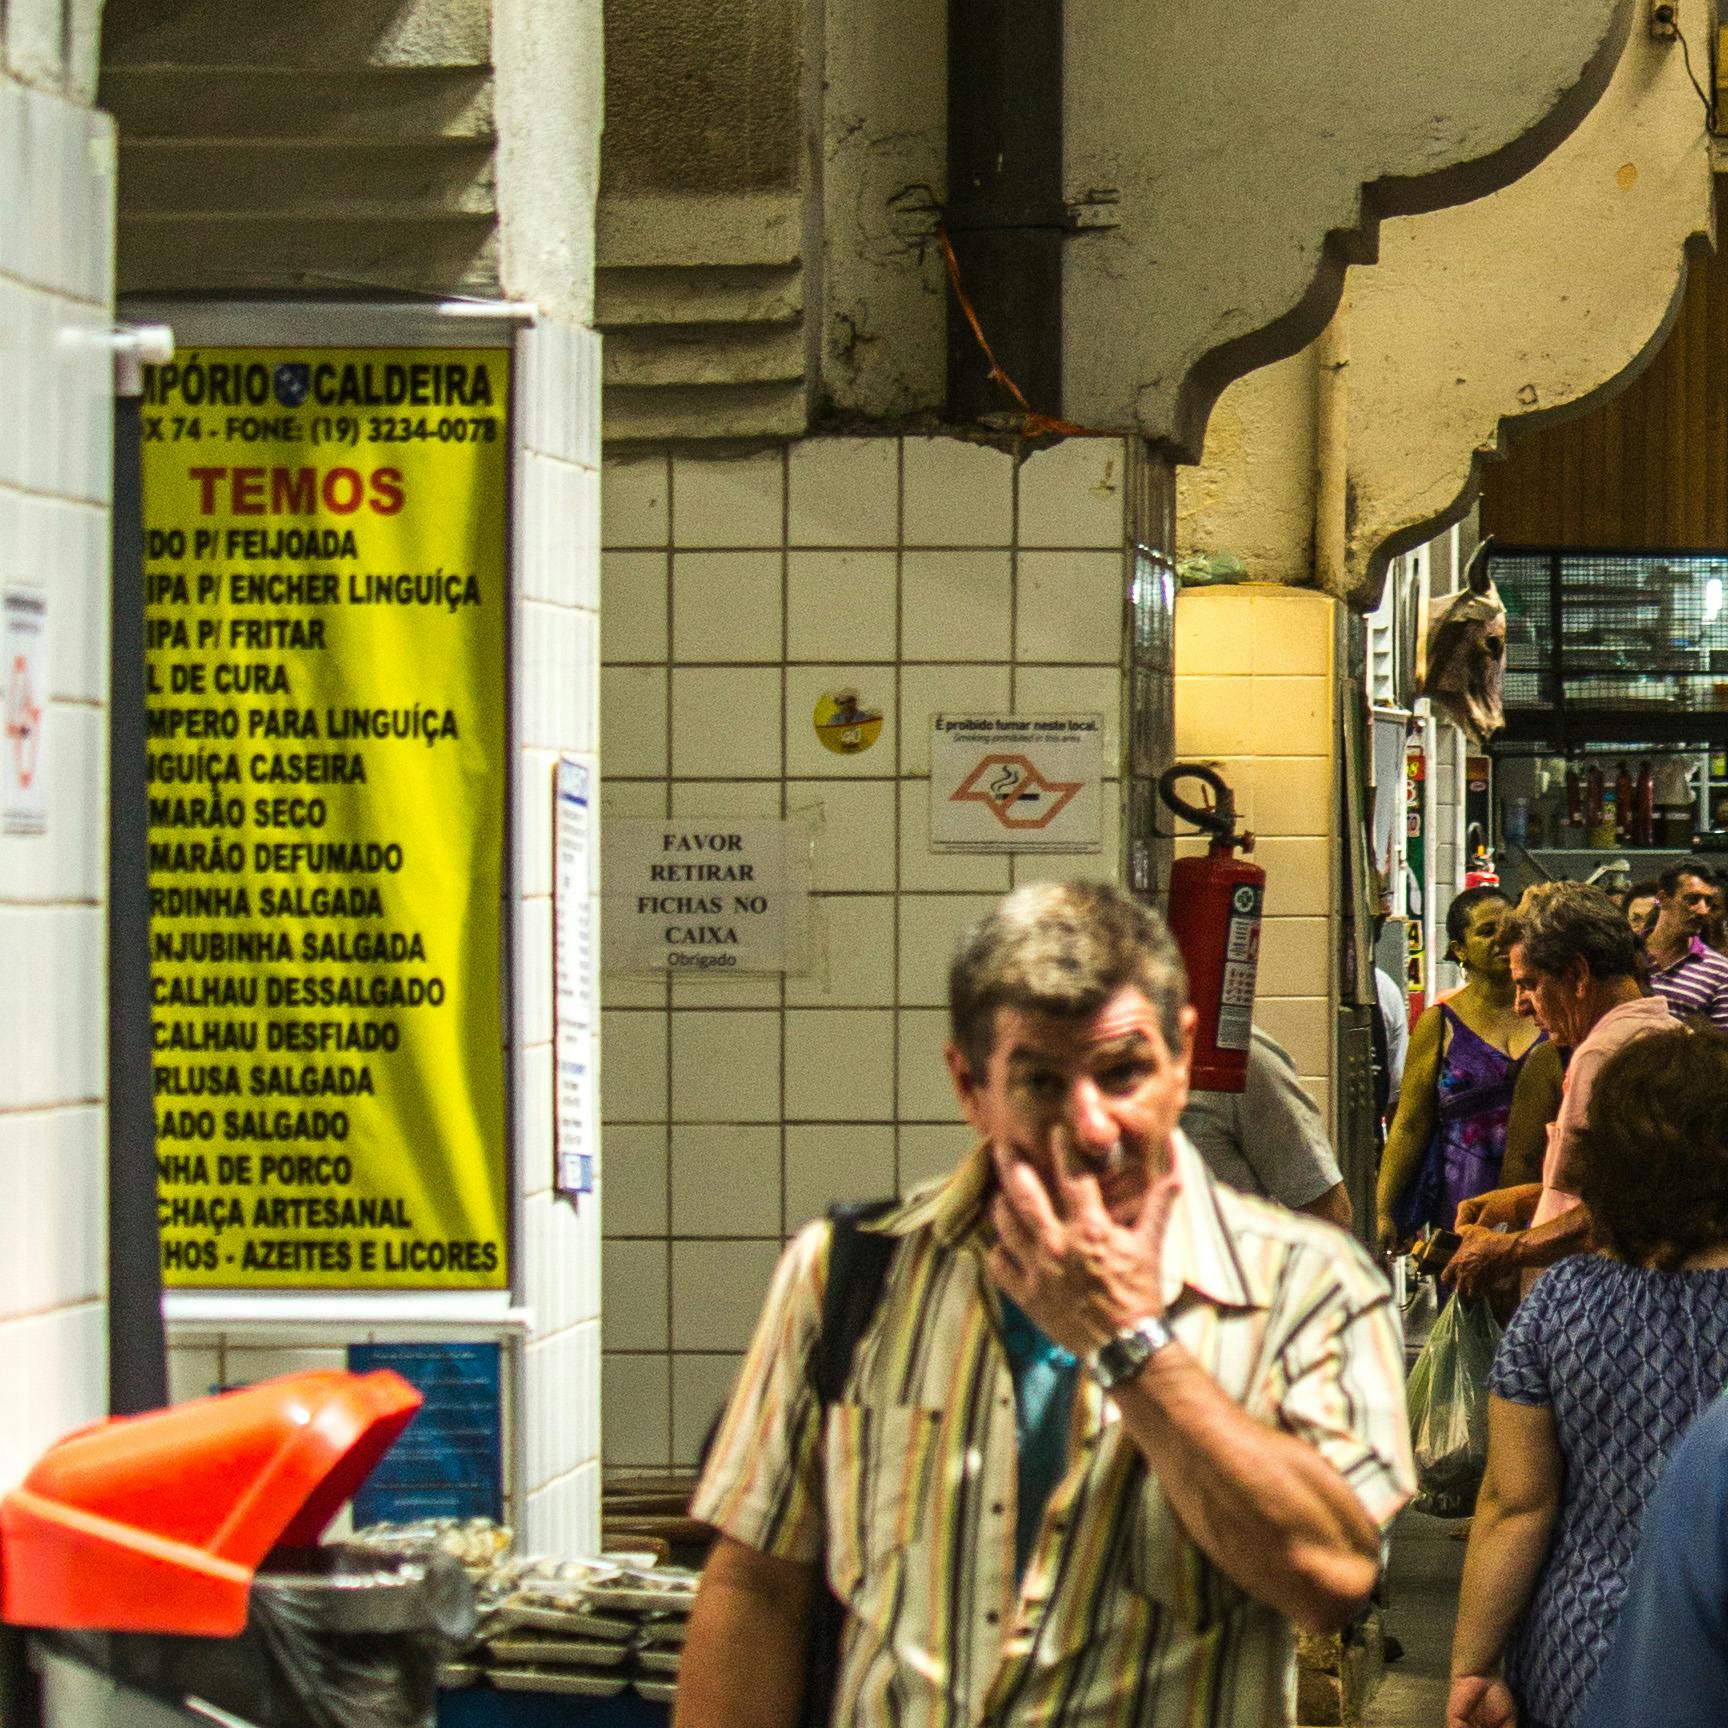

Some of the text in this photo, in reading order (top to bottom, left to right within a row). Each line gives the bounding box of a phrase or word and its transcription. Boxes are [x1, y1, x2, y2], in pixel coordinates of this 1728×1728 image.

[142, 353, 493, 406] MPÓRIO CALDEIRA
[145, 418, 164, 442] X
[172, 418, 200, 442] 74
[311, 417, 359, 446] (19)
[189, 466, 405, 517] TEMOS
[149, 529, 358, 561] DO P/ FEIJOADA
[147, 568, 481, 613] IPA P/ ENCHER LINGUÍÇA
[147, 618, 327, 650] IPA P/ FRITAR
[147, 664, 290, 695] L DE CURA
[148, 702, 459, 747] MPERO PARA LINGUÍÇA
[946, 718, 994, 733] proibido
[995, 718, 1031, 731] fumar
[1033, 719, 1066, 731] neste
[249, 753, 367, 784] CASEIRA
[149, 790, 327, 829] MARÃO SECO
[149, 836, 403, 874] MARÃO DEFUMADO
[662, 833, 744, 852] FAVOR
[649, 864, 754, 883] RETIRAR
[150, 887, 383, 918] RDINHA SALGADA
[637, 895, 768, 916] FICHAS NO
[152, 932, 426, 963] NJUBINHA SALGADA
[665, 926, 739, 945] CAIXA
[667, 950, 738, 969] Obrigado
[152, 977, 446, 1008] CALHAU DESSALGADO
[153, 1021, 400, 1052] CALHAU DESFIADO
[154, 1065, 375, 1097] RLUSA SALGADA
[156, 1110, 349, 1141] ADO SALGADO
[157, 1154, 353, 1186] NHA DE PORCO
[158, 1197, 412, 1236] CHAÇA ARTESANAL
[164, 1240, 219, 1271] HOS
[241, 1241, 352, 1271] AZEITES
[361, 1241, 377, 1271] E
[385, 1241, 498, 1272] LICORES
